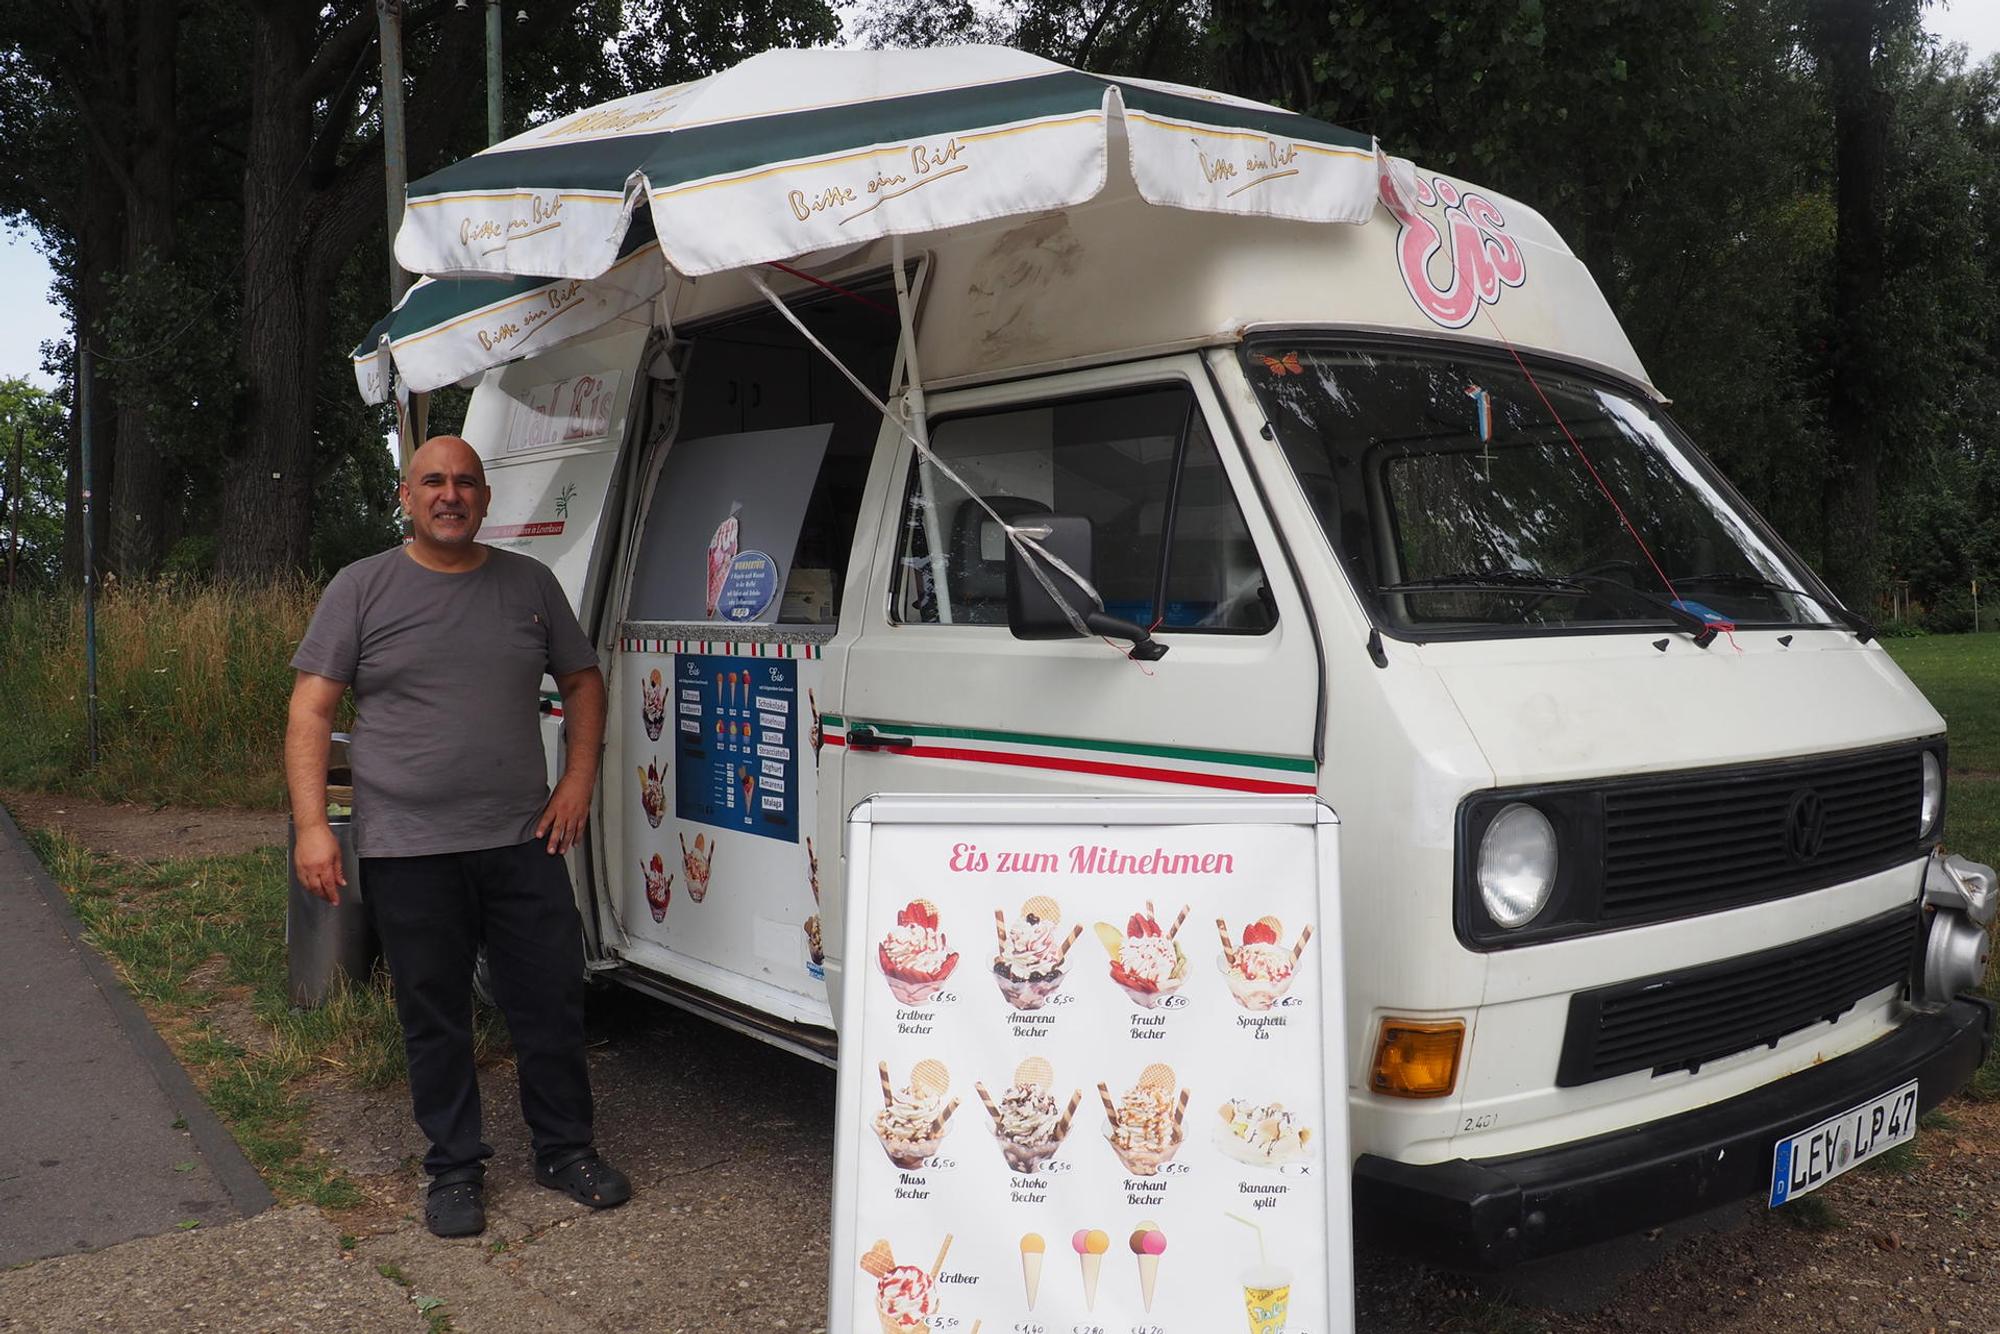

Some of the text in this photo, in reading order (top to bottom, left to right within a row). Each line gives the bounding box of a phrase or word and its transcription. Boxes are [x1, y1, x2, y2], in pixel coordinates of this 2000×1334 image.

[788, 138, 965, 221] Bitte ein Bit
[533, 195, 562, 224] Bit
[478, 280, 581, 351] Bitte ein Bit
[758, 698, 787, 711] Schokolade
[764, 732, 782, 743] Vanille
[759, 746, 789, 758] Stracciatella
[763, 763, 782, 775] Joghurt
[761, 777, 783, 790] Amarena
[763, 798, 782, 810] Malaga
[949, 842, 1234, 875] Eis zum Mitnehmen
[896, 1009, 935, 1022] Erdbeer
[1006, 1011, 1056, 1025] Amarena
[1130, 1014, 1166, 1026] Frucht
[897, 1022, 933, 1034] Becher
[1236, 1015, 1287, 1031] Spaghetti
[1012, 1025, 1049, 1037] Becher
[1129, 1027, 1167, 1040] Becher
[1254, 1027, 1270, 1040] Eis
[1790, 1089, 1916, 1193] LEV LP 47
[898, 1173, 926, 1185] Nuss
[1010, 1176, 1048, 1189] Schoko
[1123, 1179, 1168, 1191] Krokant
[894, 1187, 930, 1199] Becher
[1238, 1182, 1291, 1194] Bananen-
[1777, 1180, 1785, 1194] D
[1010, 1191, 1047, 1203] Becher
[1127, 1193, 1164, 1205] Becher
[1252, 1196, 1277, 1209] split
[939, 1271, 980, 1285] Erdbeer
[934, 1317, 959, 1329] 5,50
